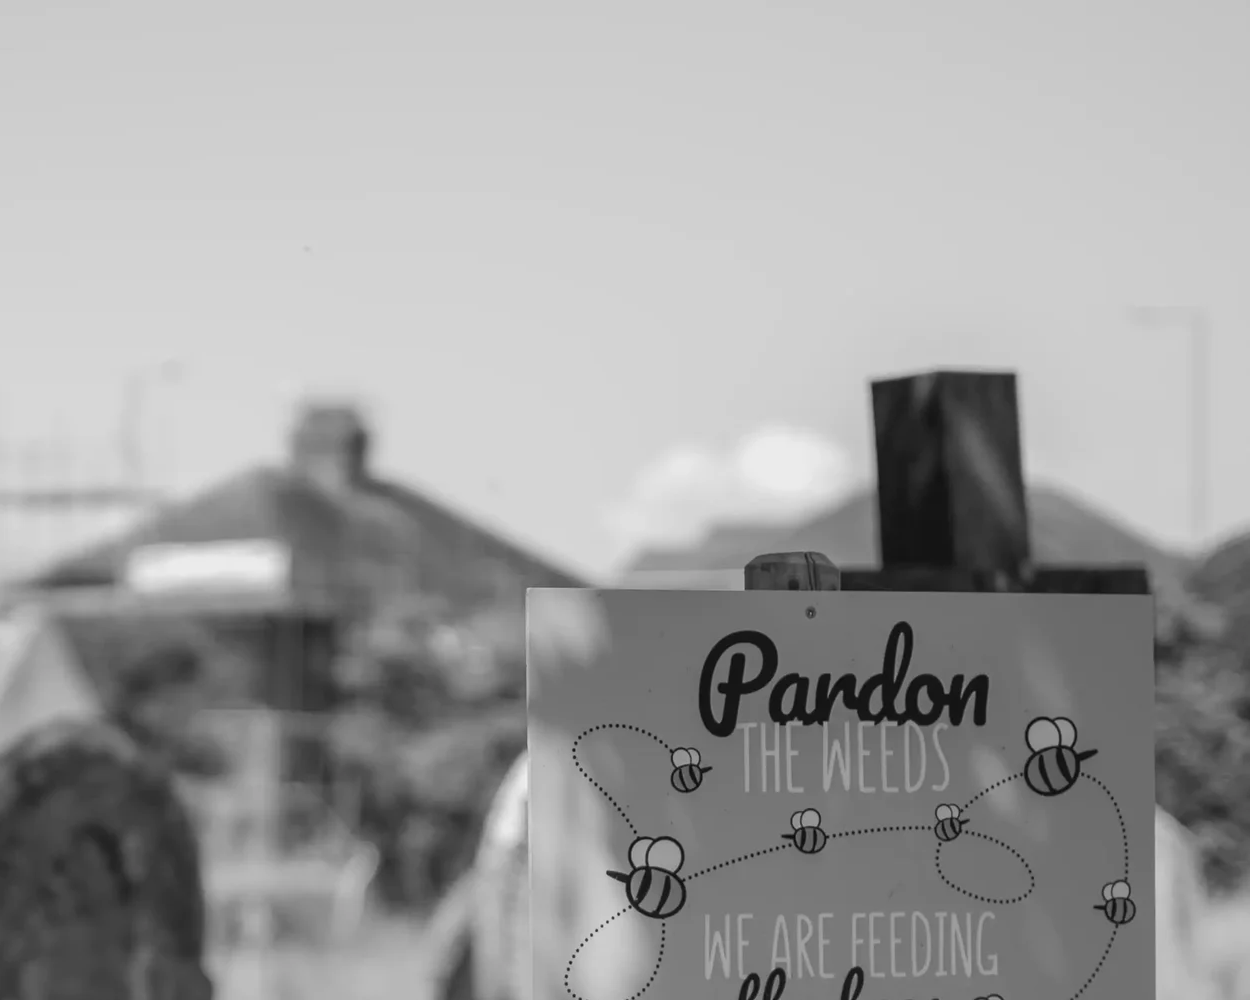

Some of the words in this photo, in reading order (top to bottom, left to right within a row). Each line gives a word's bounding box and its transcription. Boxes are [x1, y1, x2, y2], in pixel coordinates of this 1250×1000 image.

[699, 621, 990, 737] Pardon
[738, 721, 804, 793] THE
[823, 721, 950, 794] WEEDS
[704, 912, 753, 979] WE
[771, 912, 835, 979] ARE
[853, 911, 999, 978] FEEDING
